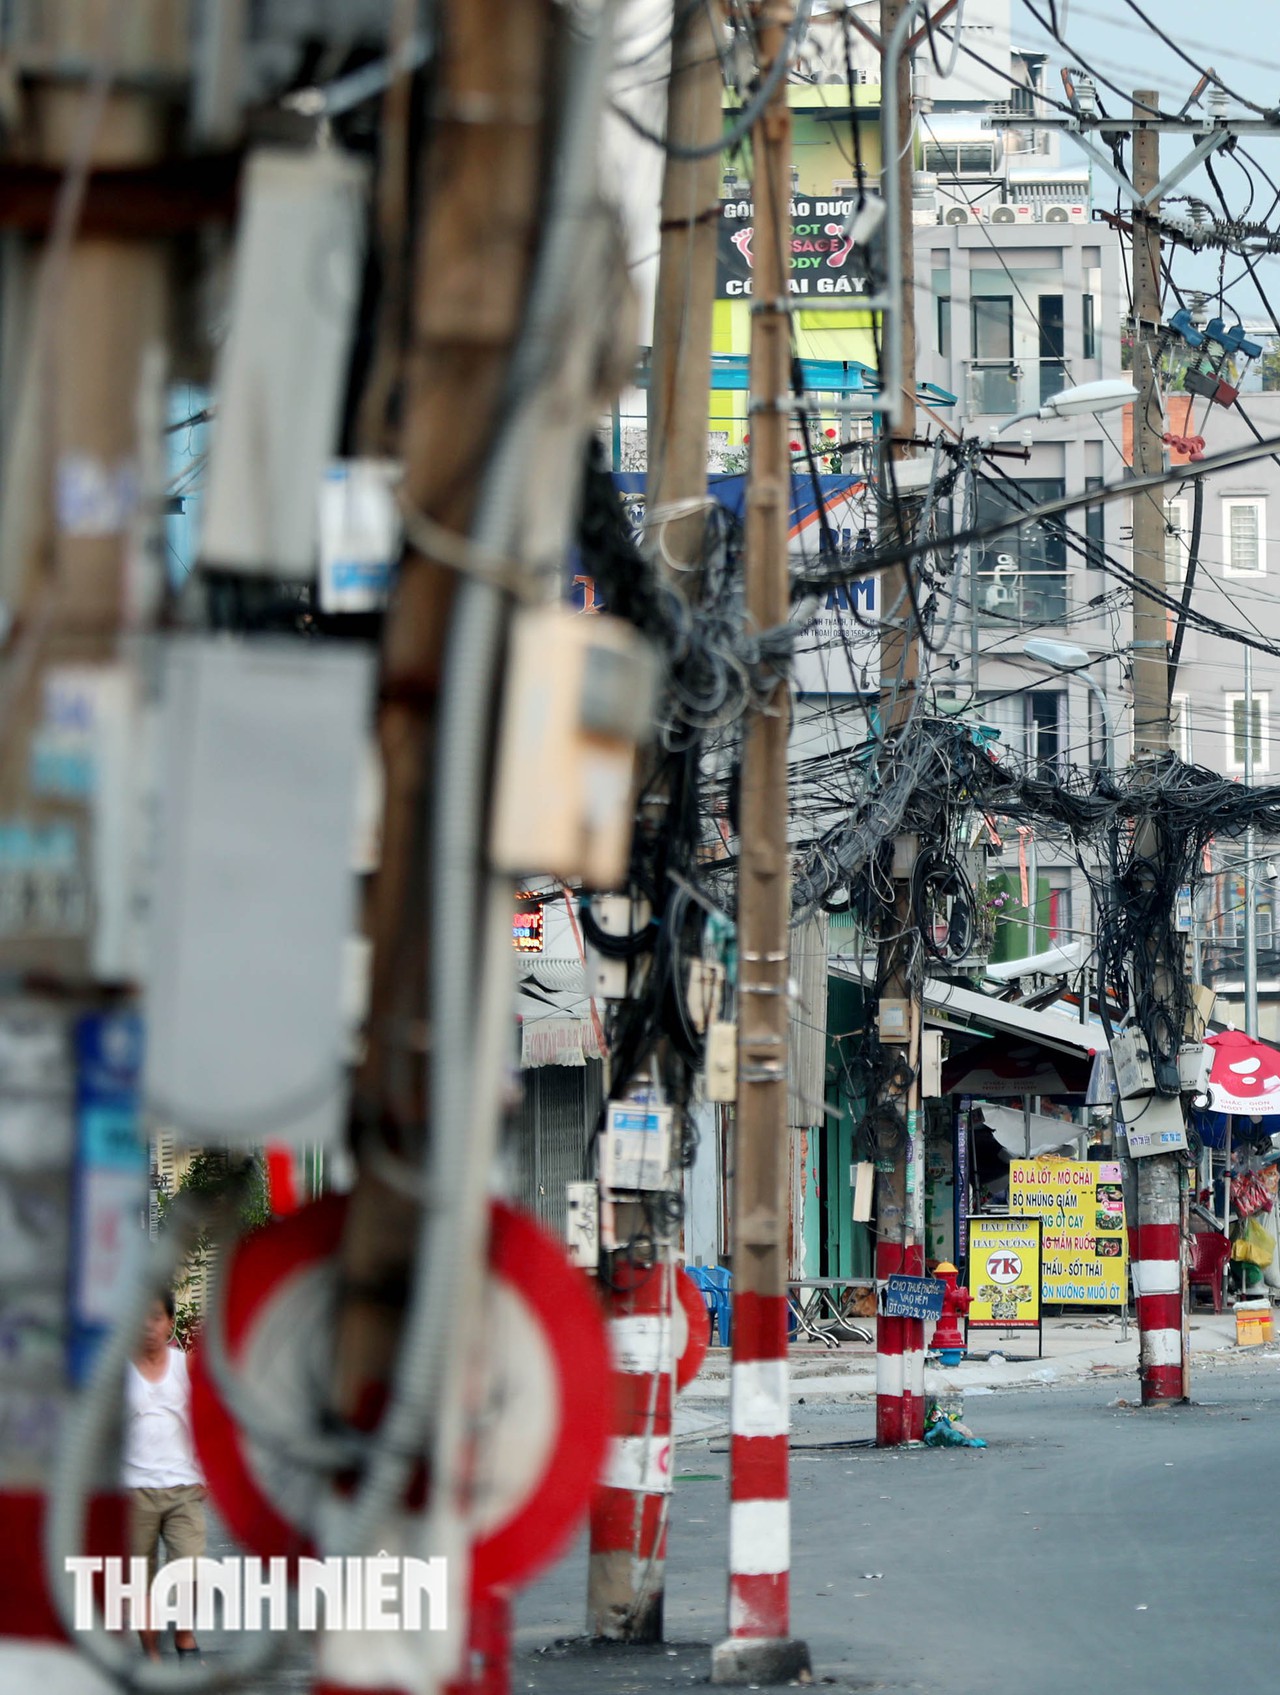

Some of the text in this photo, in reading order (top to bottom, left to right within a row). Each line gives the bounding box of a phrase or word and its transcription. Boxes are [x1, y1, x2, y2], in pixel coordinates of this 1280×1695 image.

[788, 279, 808, 293] AI
[817, 275, 866, 293] GÁY
[1026, 1190, 1053, 1206] NHÚNG
[1069, 1216, 1083, 1228] CAY
[988, 1258, 1019, 1275] 7K
[1069, 1258, 1082, 1276] SỐT
